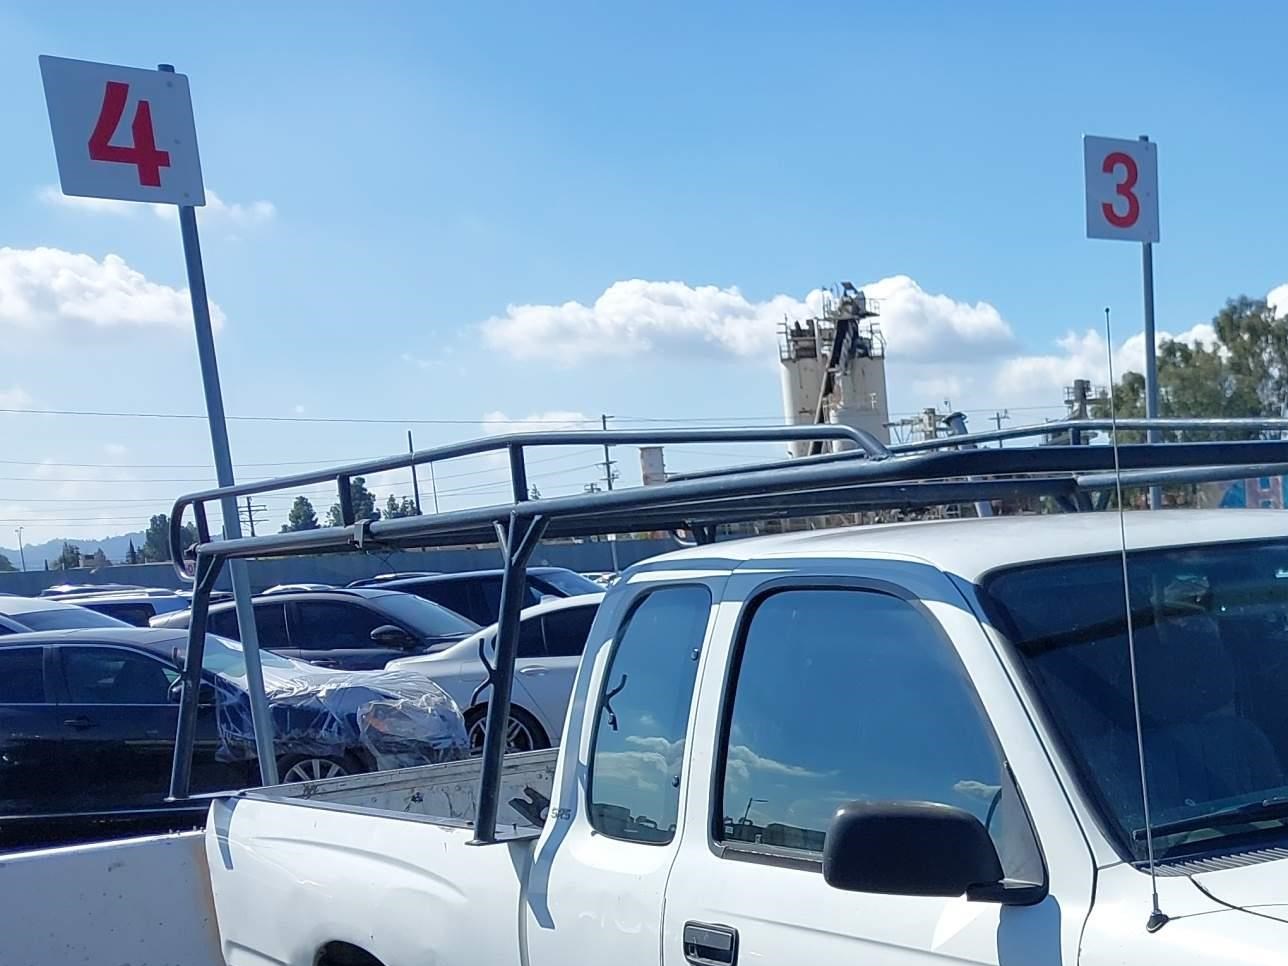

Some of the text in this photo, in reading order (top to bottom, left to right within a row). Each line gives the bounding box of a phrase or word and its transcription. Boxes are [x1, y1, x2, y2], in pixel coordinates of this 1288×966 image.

[88, 81, 171, 187] 4
[1102, 151, 1140, 228] 3
[551, 807, 571, 820] SR5
